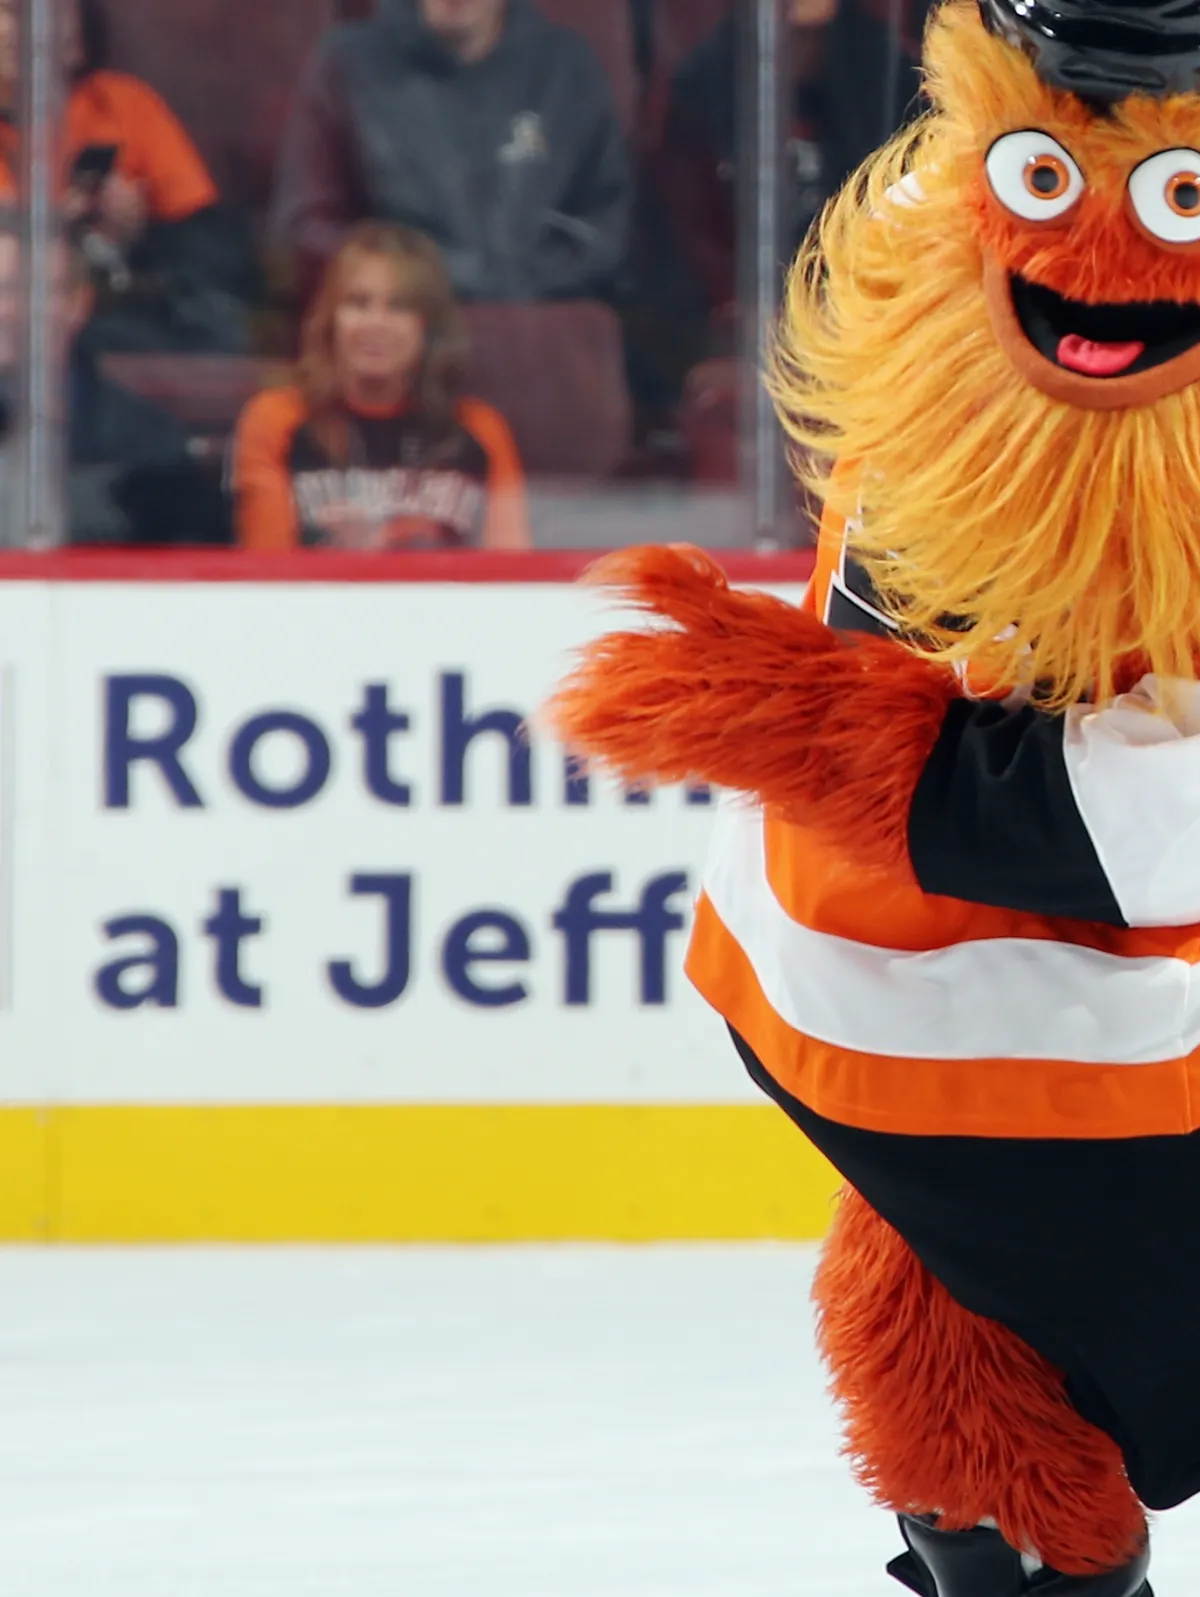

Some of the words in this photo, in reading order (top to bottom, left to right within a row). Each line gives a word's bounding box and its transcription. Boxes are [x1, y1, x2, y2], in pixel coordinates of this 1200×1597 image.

[102, 672, 712, 807] Roth
[94, 887, 263, 1009] at
[326, 871, 688, 1009] Jeff
